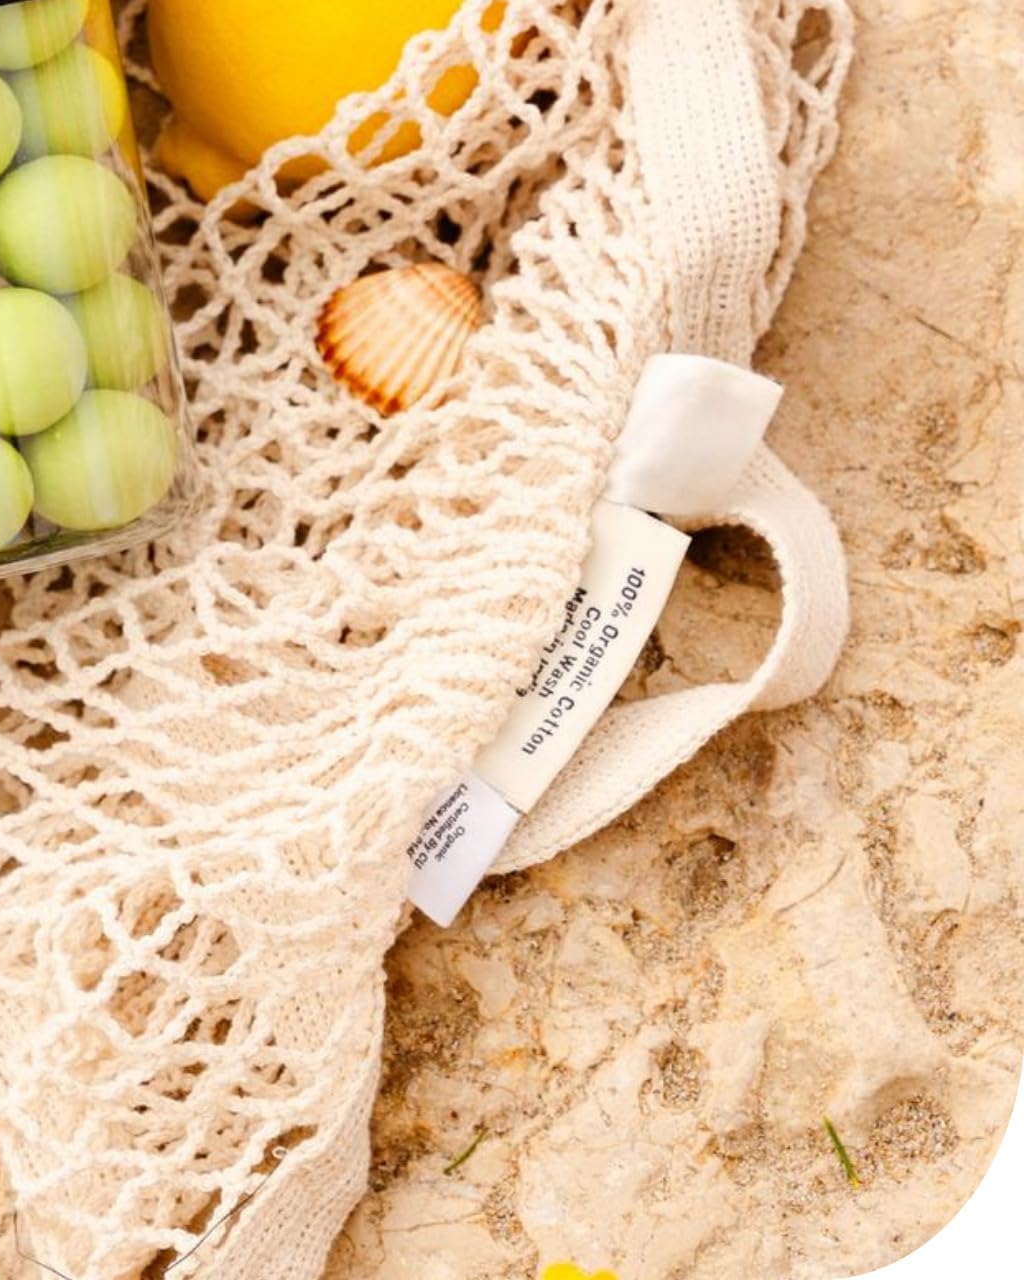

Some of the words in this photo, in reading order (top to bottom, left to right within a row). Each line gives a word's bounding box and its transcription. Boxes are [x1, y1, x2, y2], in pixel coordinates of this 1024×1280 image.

[611, 568, 646, 618] 100%
[572, 607, 602, 649] Cool
[538, 654, 578, 698] Wash
[570, 625, 619, 692] Organic
[522, 696, 575, 755] Cotton
[434, 802, 469, 840] Certified
[423, 838, 438, 853] By
[435, 826, 465, 861] Organic
